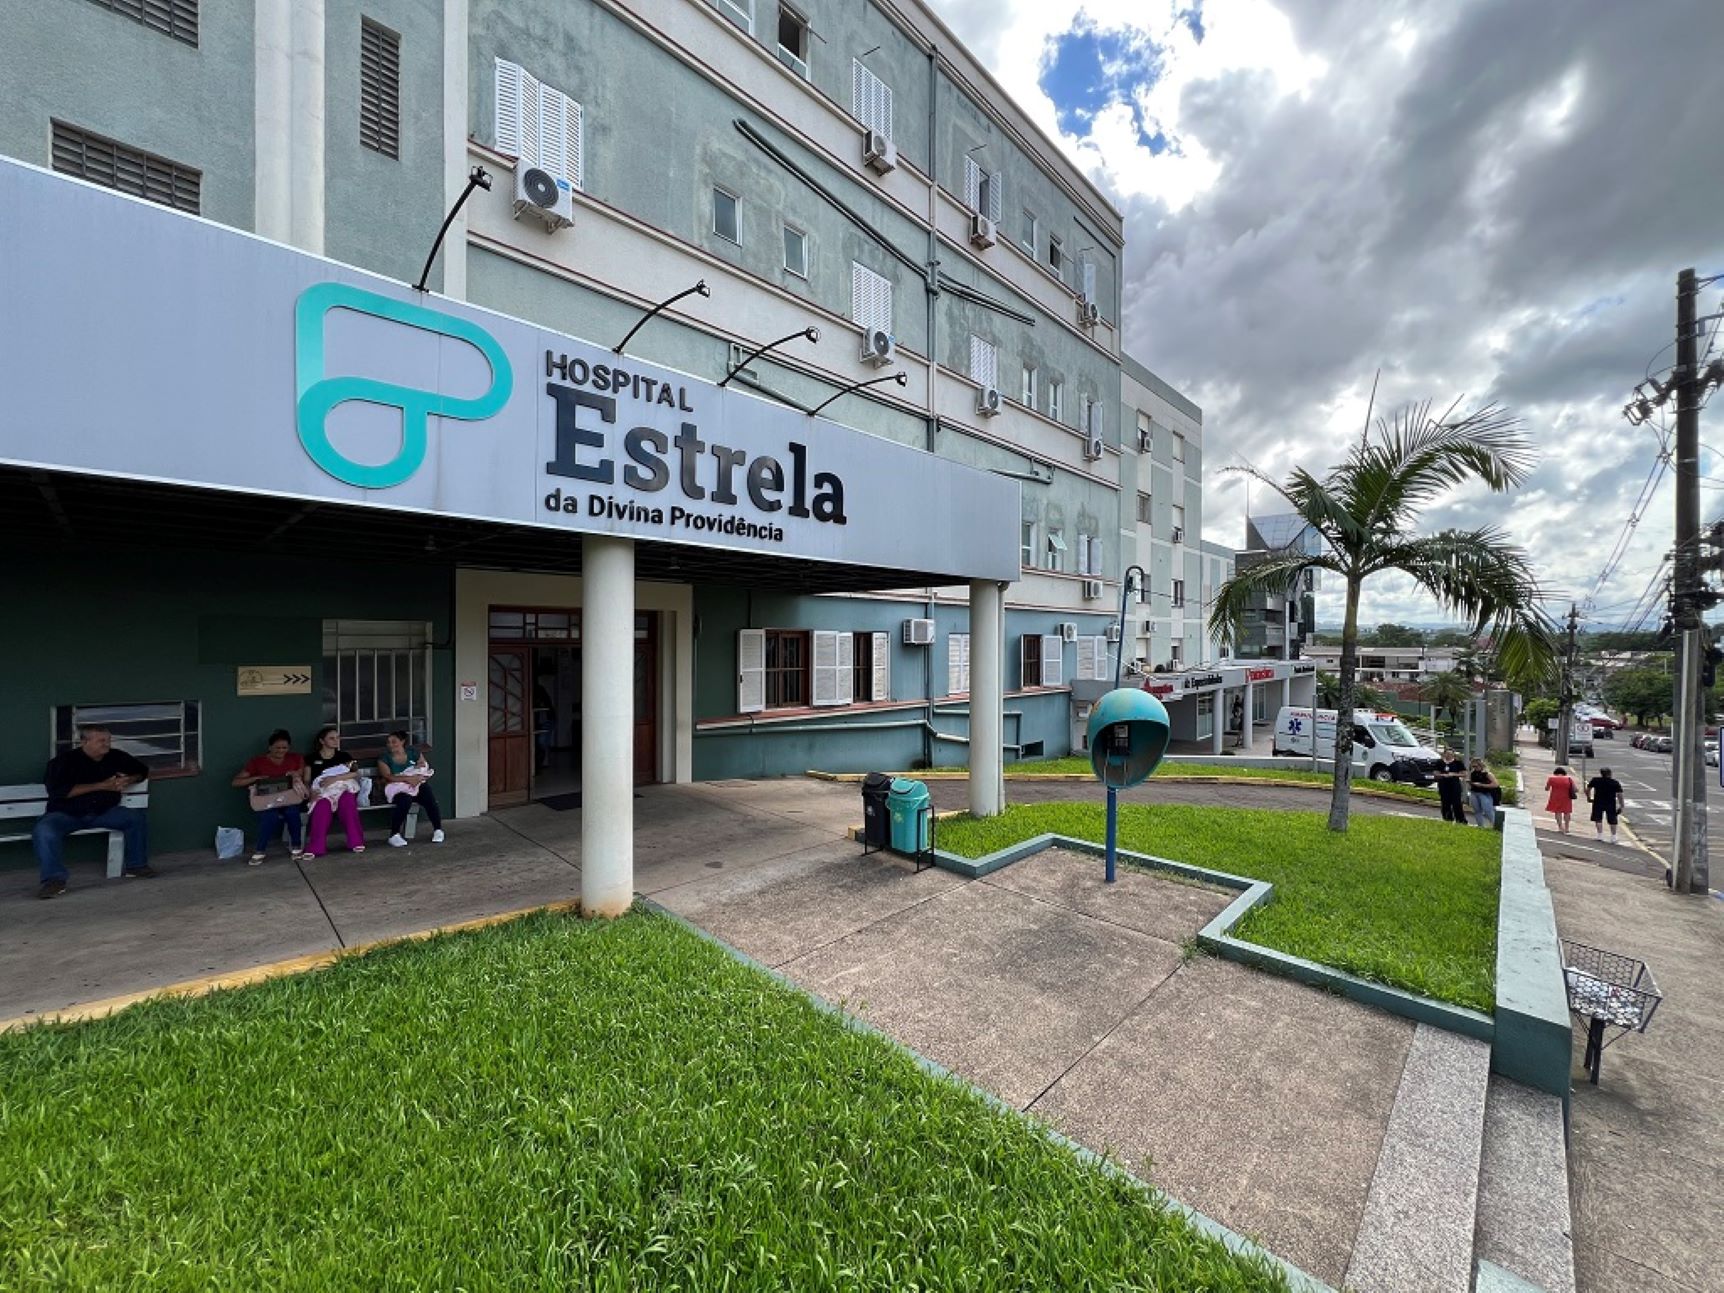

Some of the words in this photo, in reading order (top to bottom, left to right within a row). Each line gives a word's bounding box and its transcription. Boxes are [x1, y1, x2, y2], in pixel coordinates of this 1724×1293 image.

[546, 350, 693, 413] HOSPITAL
[546, 381, 847, 525] Estrela
[545, 488, 578, 513] da
[588, 494, 664, 525] Divina
[670, 505, 784, 542] Providência
[1290, 710, 1336, 721] AMBULNCIA
